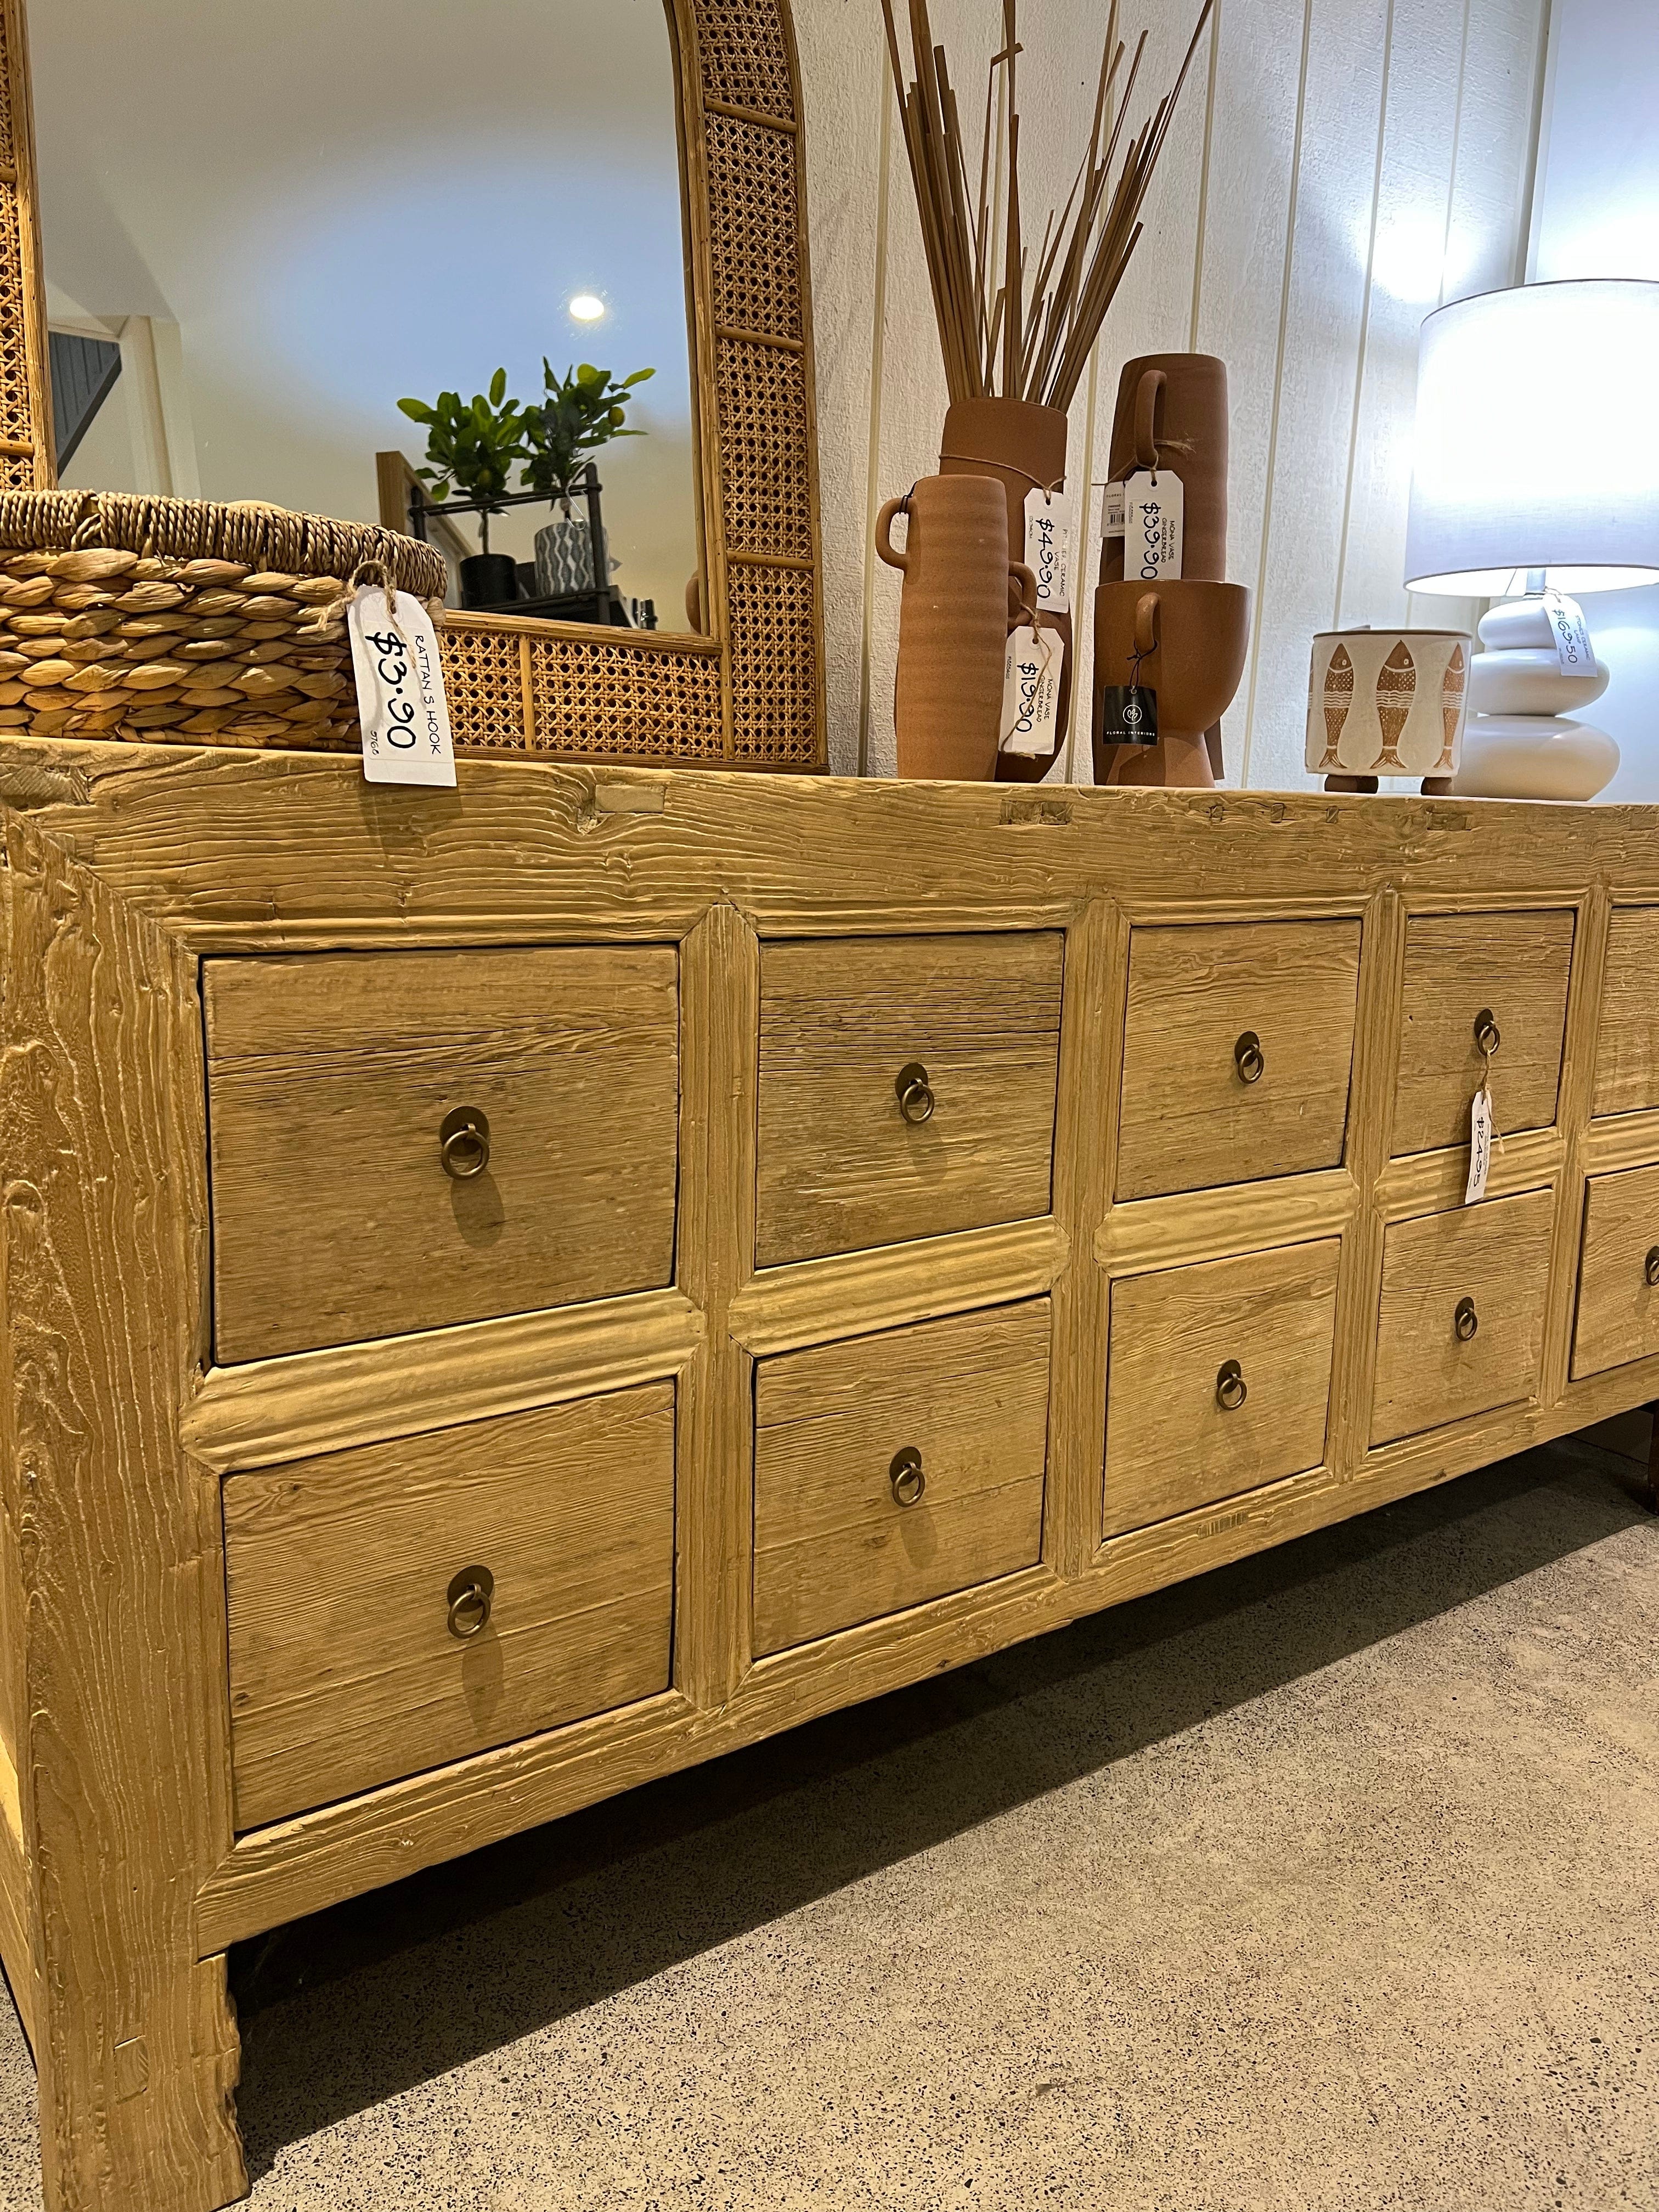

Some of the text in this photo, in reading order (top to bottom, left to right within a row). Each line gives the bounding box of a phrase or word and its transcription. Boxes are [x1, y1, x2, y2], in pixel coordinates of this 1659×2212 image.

[1035, 518, 1055, 599] $49.90
[1139, 502, 1161, 580] $39.90
[1551, 609, 1578, 663] $169.50
[1581, 636, 1590, 661] CERAMIC
[365, 631, 417, 749] $3.90
[414, 635, 442, 755] RATTAN S HOOK
[1017, 662, 1039, 732] $19.90
[1036, 675, 1046, 723] GINGERBREAD
[1473, 1116, 1485, 1187] $2495
